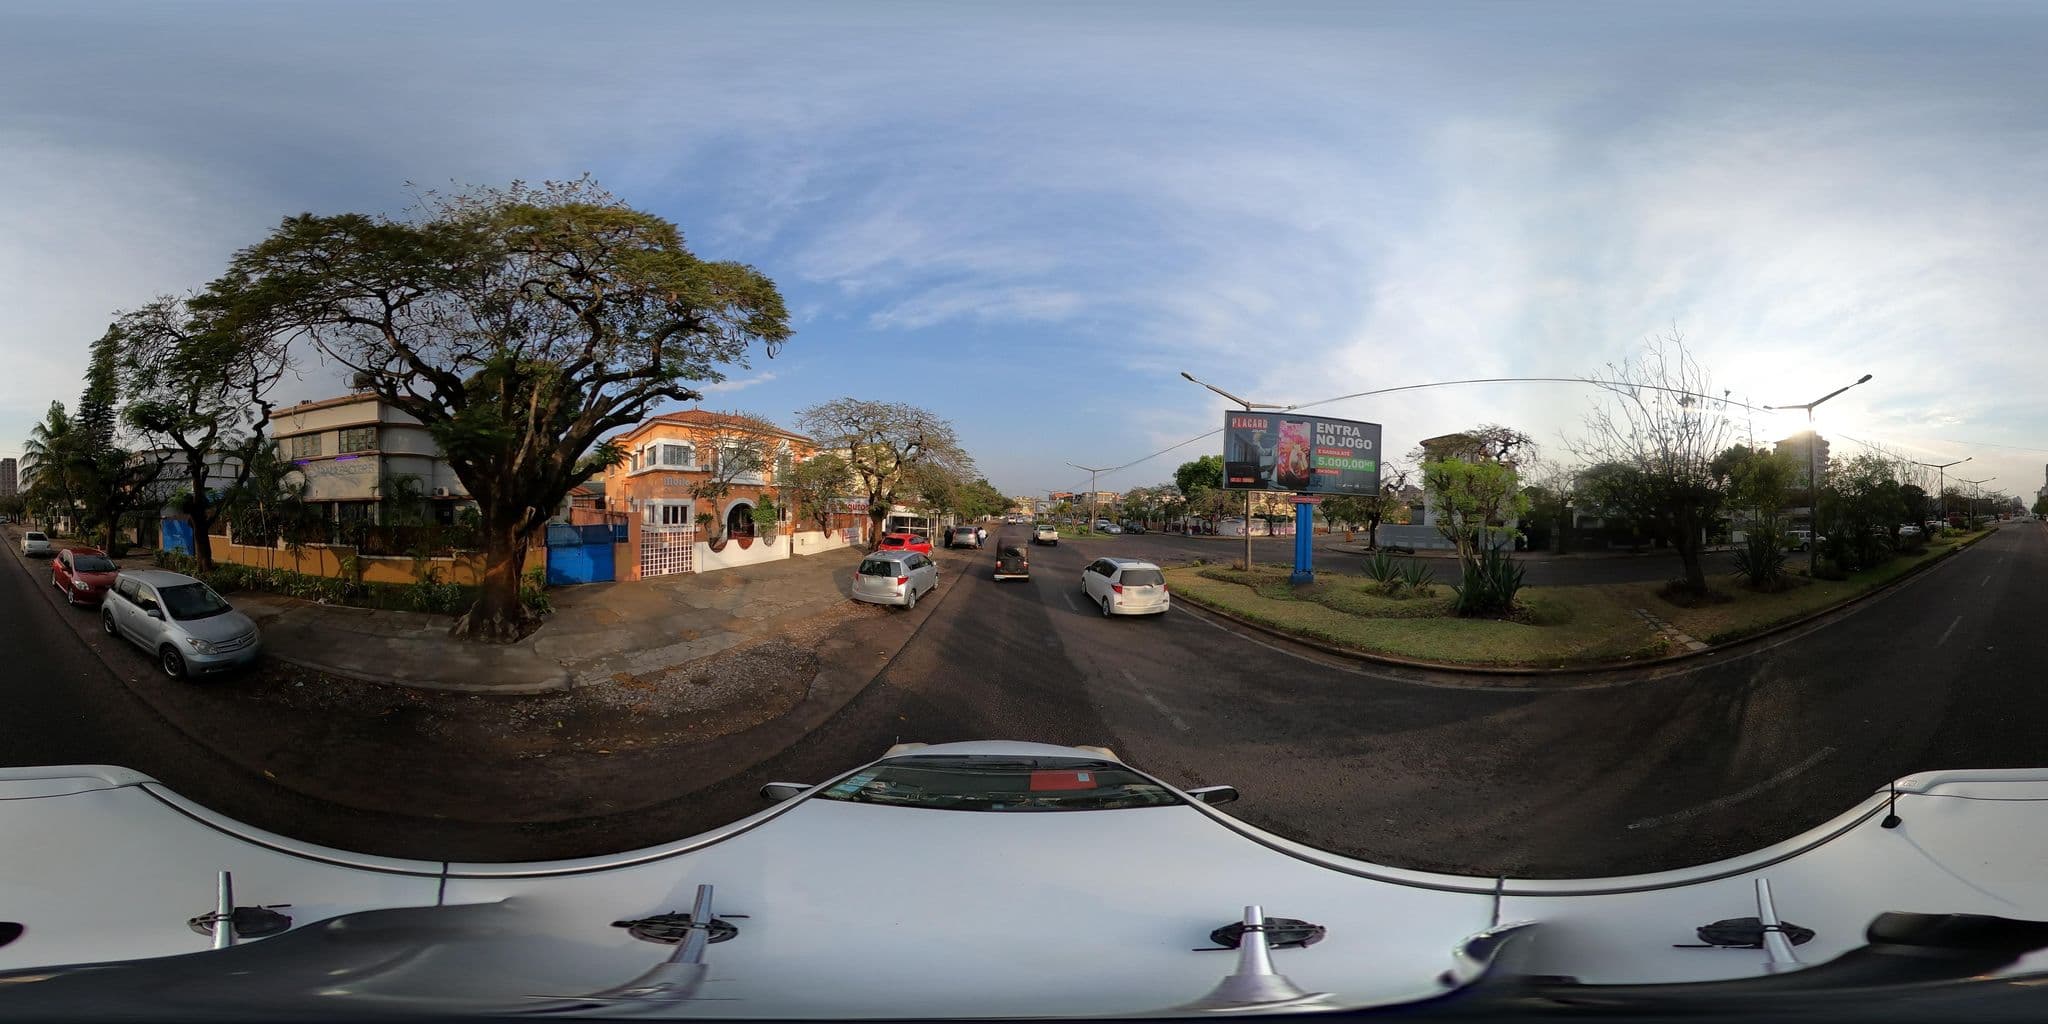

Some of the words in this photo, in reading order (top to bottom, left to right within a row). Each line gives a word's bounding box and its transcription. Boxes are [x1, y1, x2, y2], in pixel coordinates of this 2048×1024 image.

[1232, 417, 1268, 429] PLACARD
[1316, 422, 1360, 437] ENTRA
[1316, 434, 1336, 446] NO
[1338, 436, 1372, 450] JOGO
